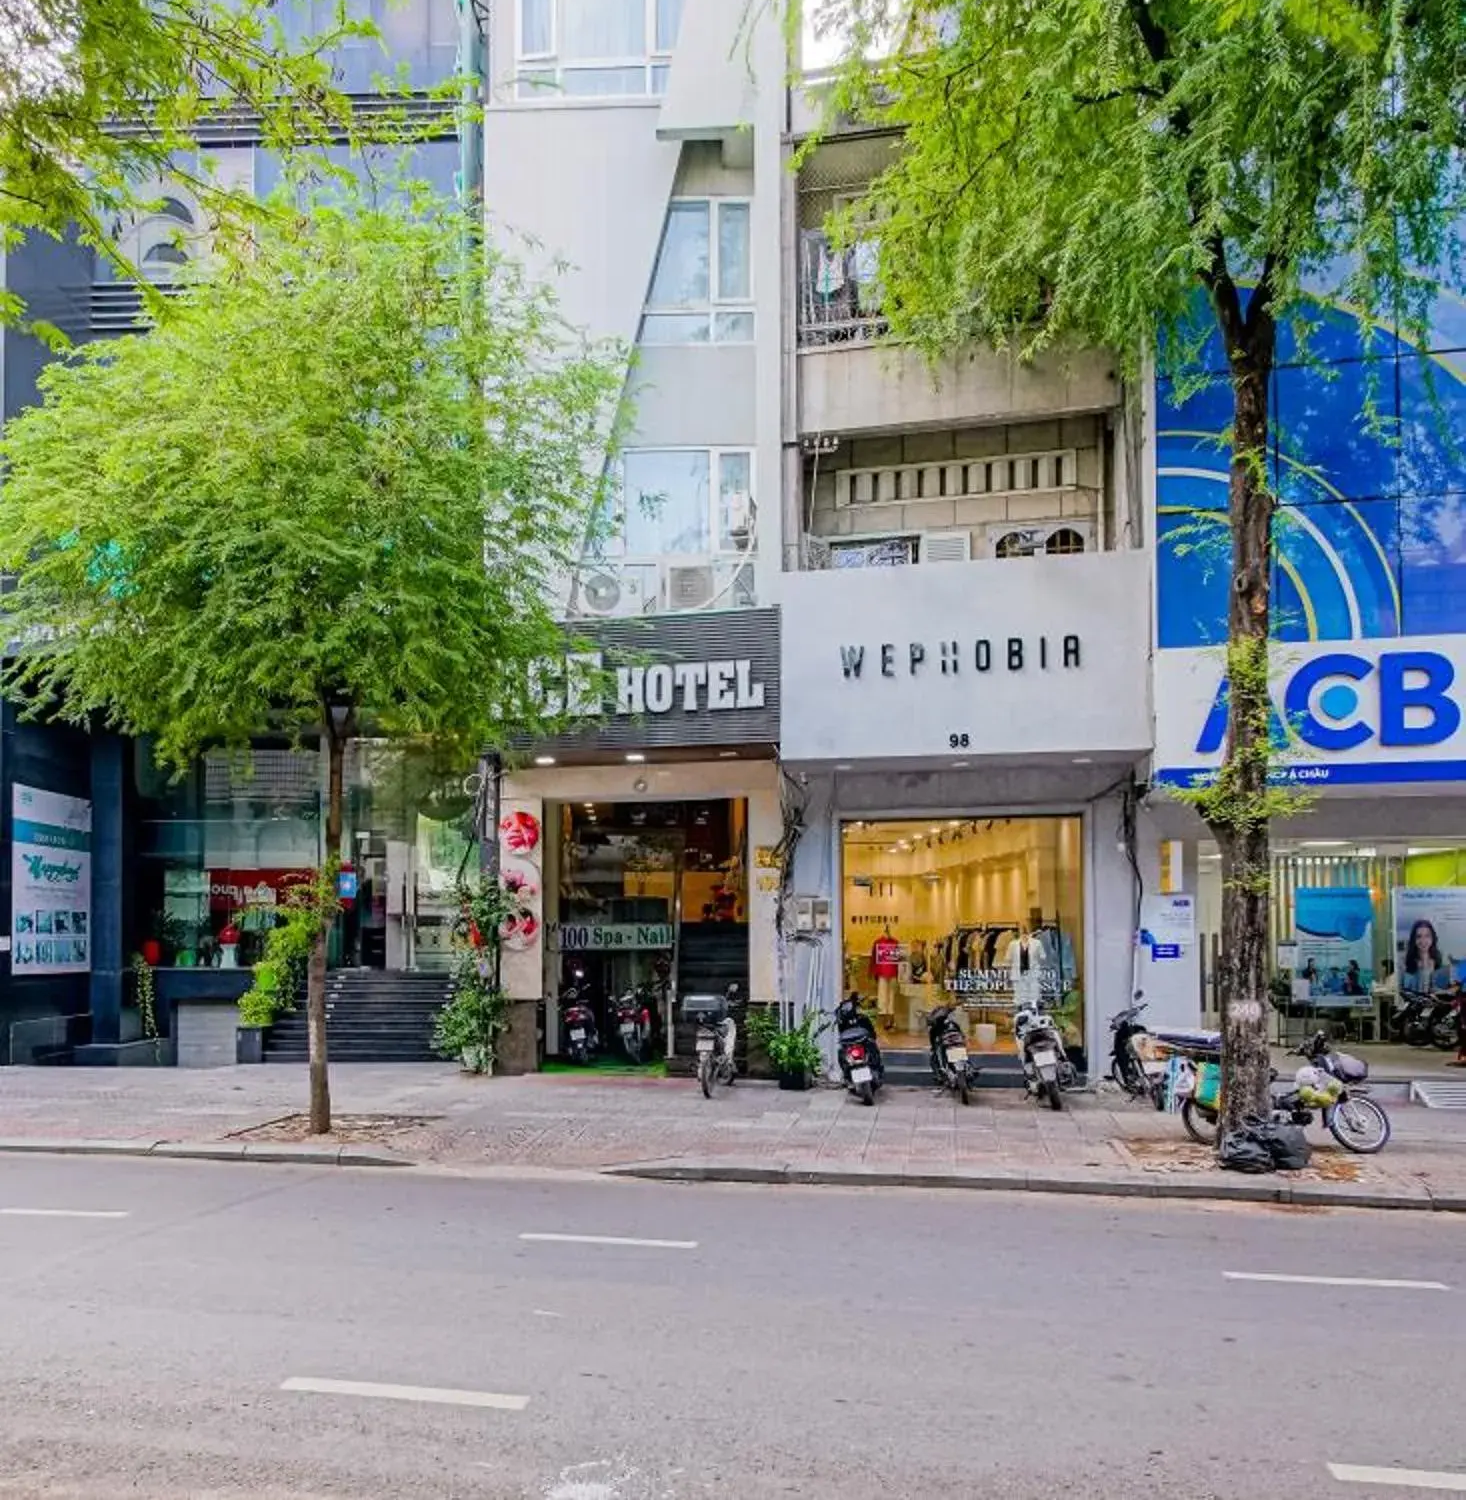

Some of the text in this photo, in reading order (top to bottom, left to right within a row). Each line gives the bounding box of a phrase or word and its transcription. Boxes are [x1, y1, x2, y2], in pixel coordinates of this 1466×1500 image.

[839, 634, 1081, 679] WEPHOBIA
[615, 659, 765, 714] HOTEL
[949, 733, 970, 748] 98
[593, 926, 624, 948] Spa
[638, 925, 673, 945] Nail
[958, 967, 1014, 979] SUMME
